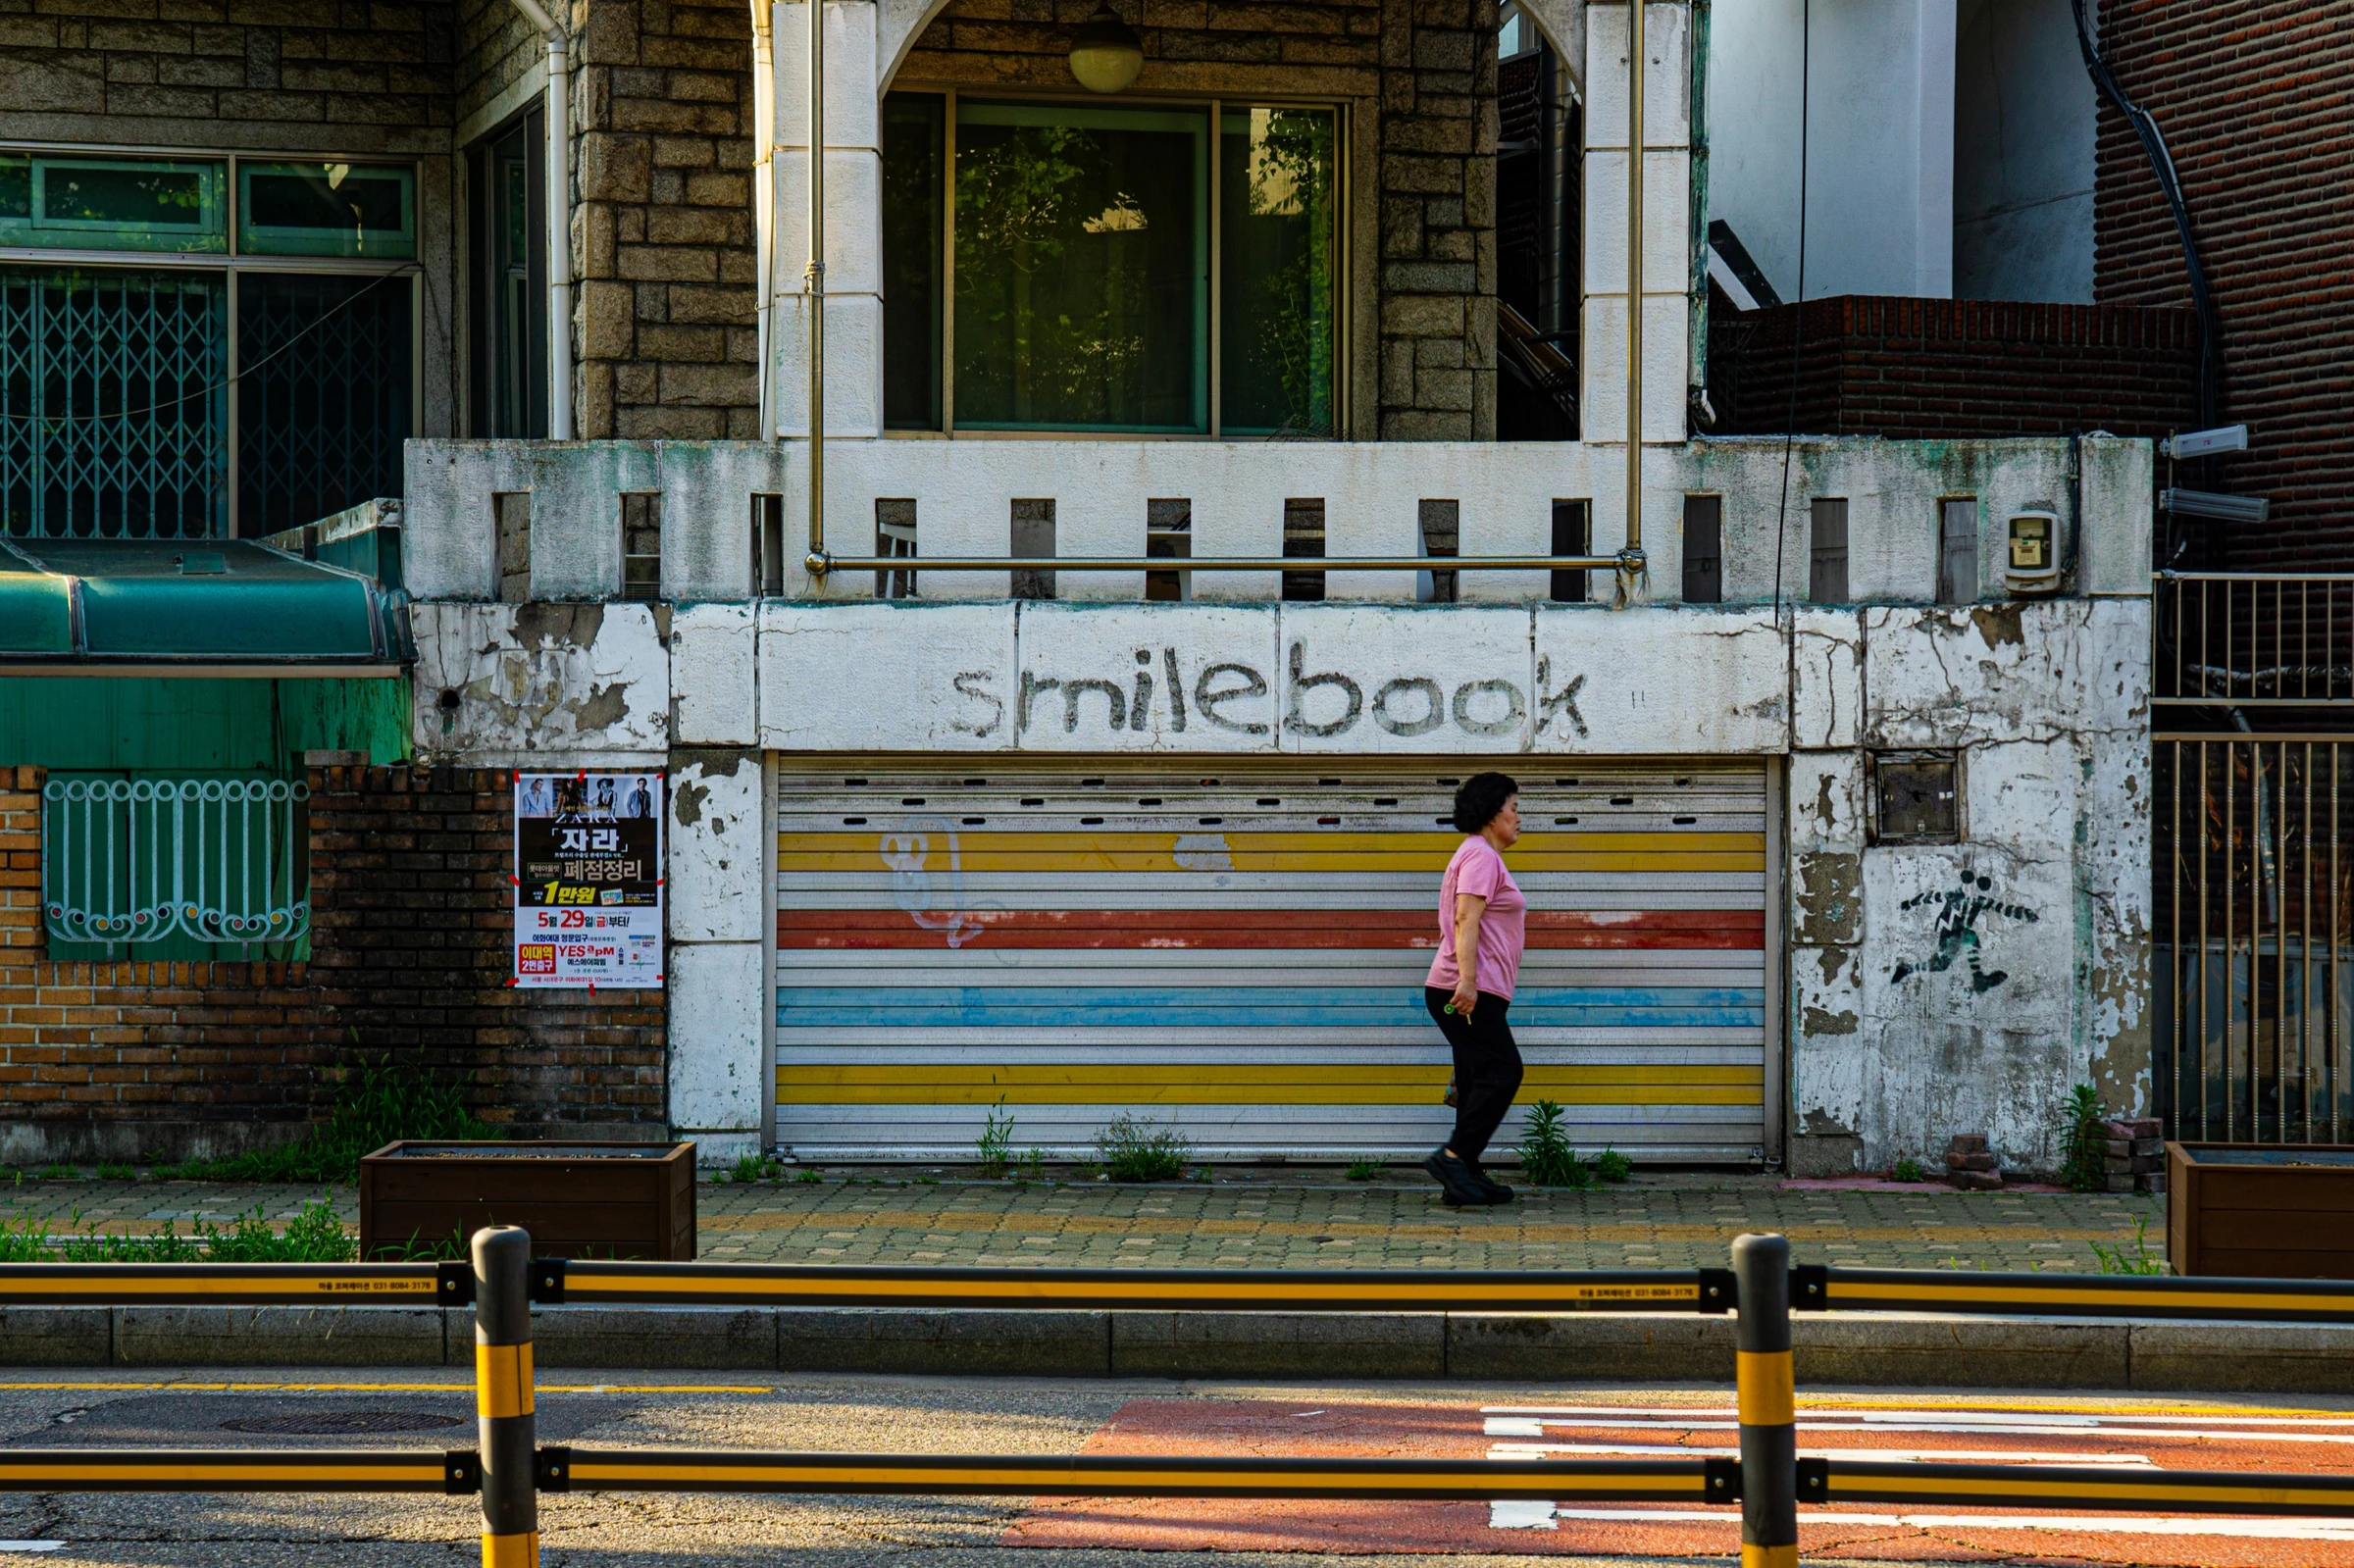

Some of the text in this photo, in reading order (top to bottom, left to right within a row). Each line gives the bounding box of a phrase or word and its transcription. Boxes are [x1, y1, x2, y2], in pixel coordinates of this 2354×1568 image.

[951, 637, 1588, 739] smilebook
[555, 814, 619, 824] ZARA
[564, 859, 641, 882] 폐점정리
[544, 881, 596, 904] 1만원
[537, 911, 557, 928] 5월
[533, 934, 559, 942] 이화여대
[521, 945, 553, 960] 이대역
[558, 945, 586, 957] YES
[521, 960, 553, 972] 2번출구
